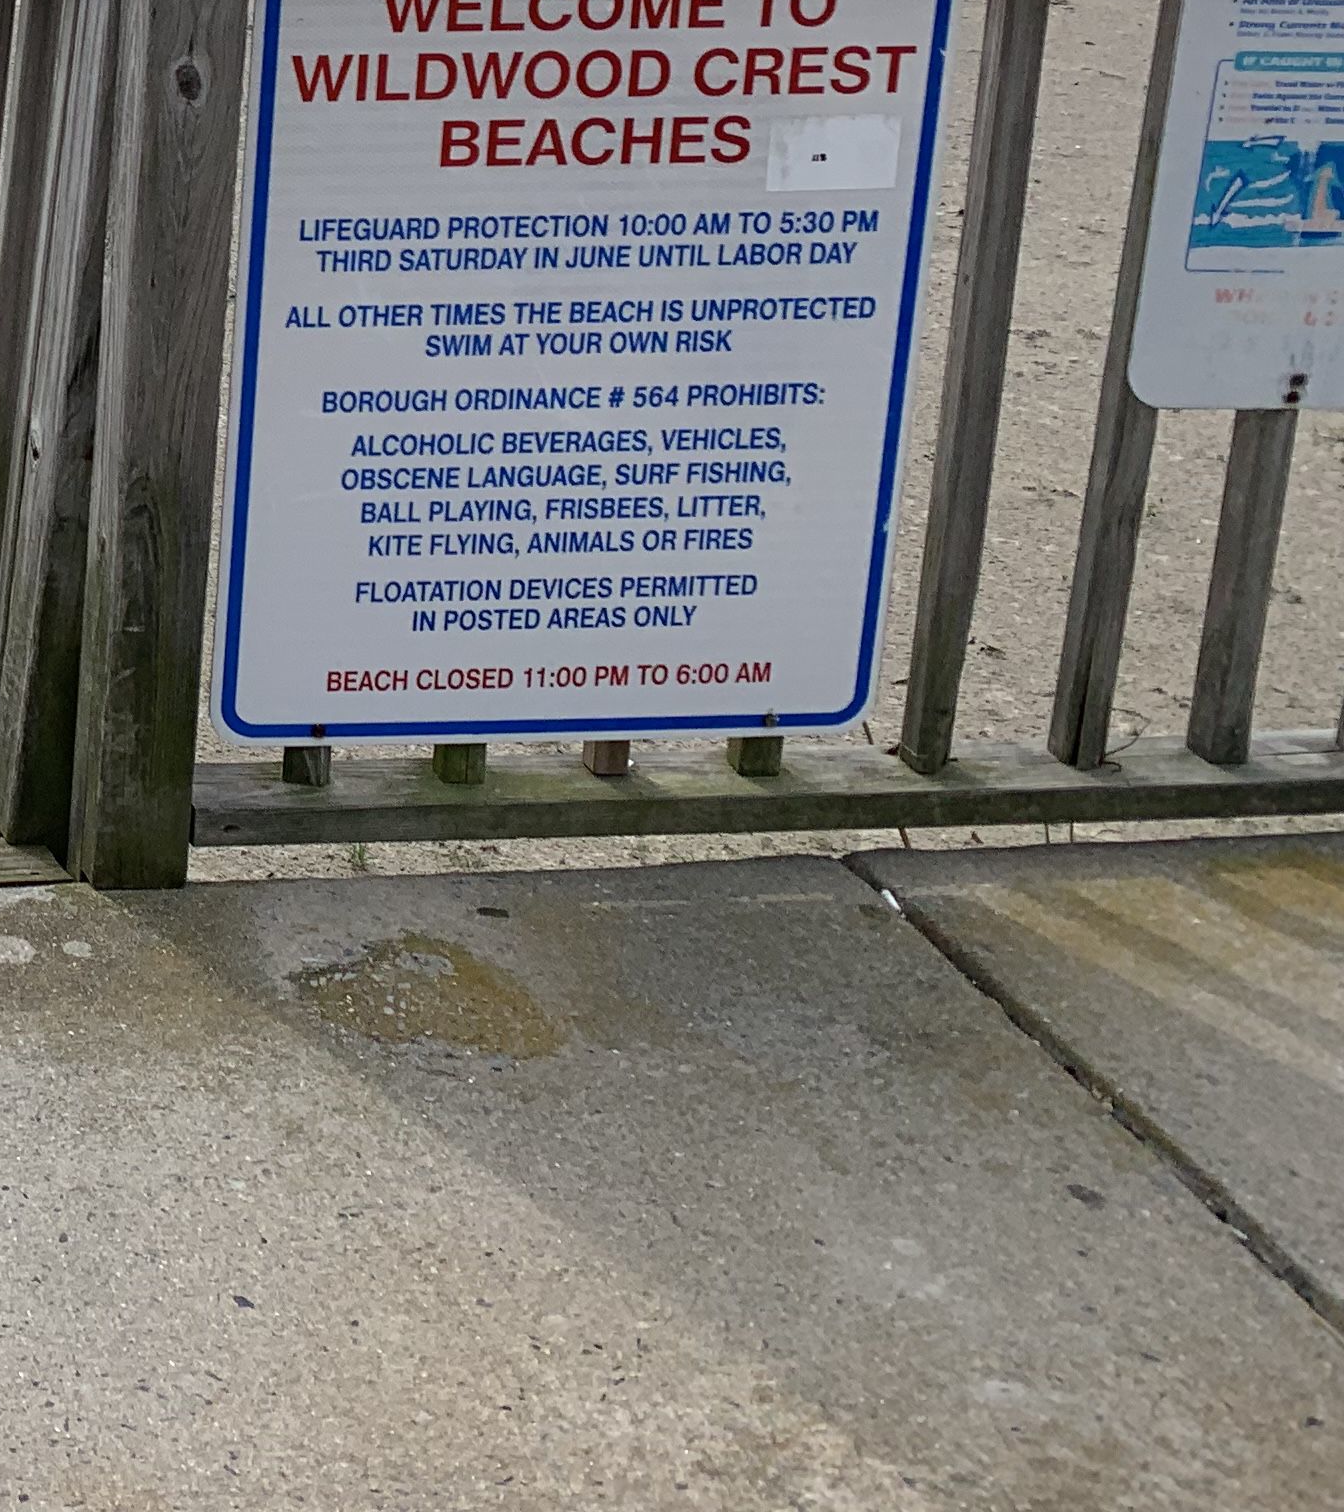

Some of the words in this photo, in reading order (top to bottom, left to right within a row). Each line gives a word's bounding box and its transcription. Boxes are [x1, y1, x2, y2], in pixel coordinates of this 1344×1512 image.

[291, 50, 671, 102] WILDWOOD
[694, 46, 917, 97] CREST
[440, 115, 751, 167] BEACHES
[299, 217, 440, 241] LIFEGUARD
[448, 214, 609, 239] PROTECTION
[619, 213, 687, 236] 10:00
[693, 212, 731, 235] AM
[738, 212, 771, 234] TO
[779, 211, 834, 234] 5:30
[841, 210, 879, 232] PM
[316, 249, 391, 272] THIRD
[399, 247, 529, 271] SATURDAY
[534, 247, 559, 269] IN
[565, 245, 632, 269] JUNE
[639, 244, 711, 268] UNTIL
[717, 242, 803, 266] LABOR
[809, 242, 857, 264] DAY
[285, 306, 331, 328] ALL
[338, 304, 423, 327] OTHER
[430, 303, 505, 326] TIMES
[513, 302, 562, 324] THE
[569, 300, 654, 323] BEACH
[661, 300, 684, 322] IS
[691, 296, 876, 321] UNPROTECTED
[425, 334, 492, 357] SWIM
[498, 333, 530, 355] AT
[536, 332, 602, 355] YOUR
[609, 331, 668, 354] OWN
[676, 329, 732, 353] RISK
[322, 390, 447, 413] BOROUGH
[455, 387, 602, 411] ORDINANCE
[608, 386, 625, 408] #
[633, 385, 679, 408] 564
[687, 382, 825, 406] PROHIBITS:
[351, 432, 495, 457] ALCOHOLIC
[502, 429, 653, 456] BEVERAGES,
[661, 427, 786, 453] VEHICLES,
[341, 467, 460, 490] OBSCENE
[468, 464, 607, 490] LANGUAGE,
[615, 463, 681, 485] SURF
[687, 460, 791, 486] FISHING,
[361, 501, 421, 523] BALL
[429, 499, 537, 524] PLAYING,
[546, 496, 669, 521] FRISBEES,
[677, 495, 765, 519] LITTER,
[369, 535, 423, 556] KITE
[430, 533, 519, 558] FLYING,
[527, 530, 634, 553] ANIMALS
[642, 530, 677, 551] OR
[684, 528, 753, 550] FIRES
[356, 580, 501, 603] FLOATATION
[509, 577, 613, 600] DEVICES
[620, 575, 757, 598] PERMITTED
[412, 610, 436, 631] IN
[444, 609, 540, 631] POSTED
[547, 606, 626, 629] AREAS
[634, 605, 697, 627] ONLY
[327, 670, 408, 692] BEACH
[416, 668, 513, 690] CLOSED
[524, 667, 587, 688] 11:00
[595, 665, 629, 686] PM
[637, 664, 668, 685] TO
[676, 663, 729, 685] 6:00
[735, 662, 771, 683] AM
